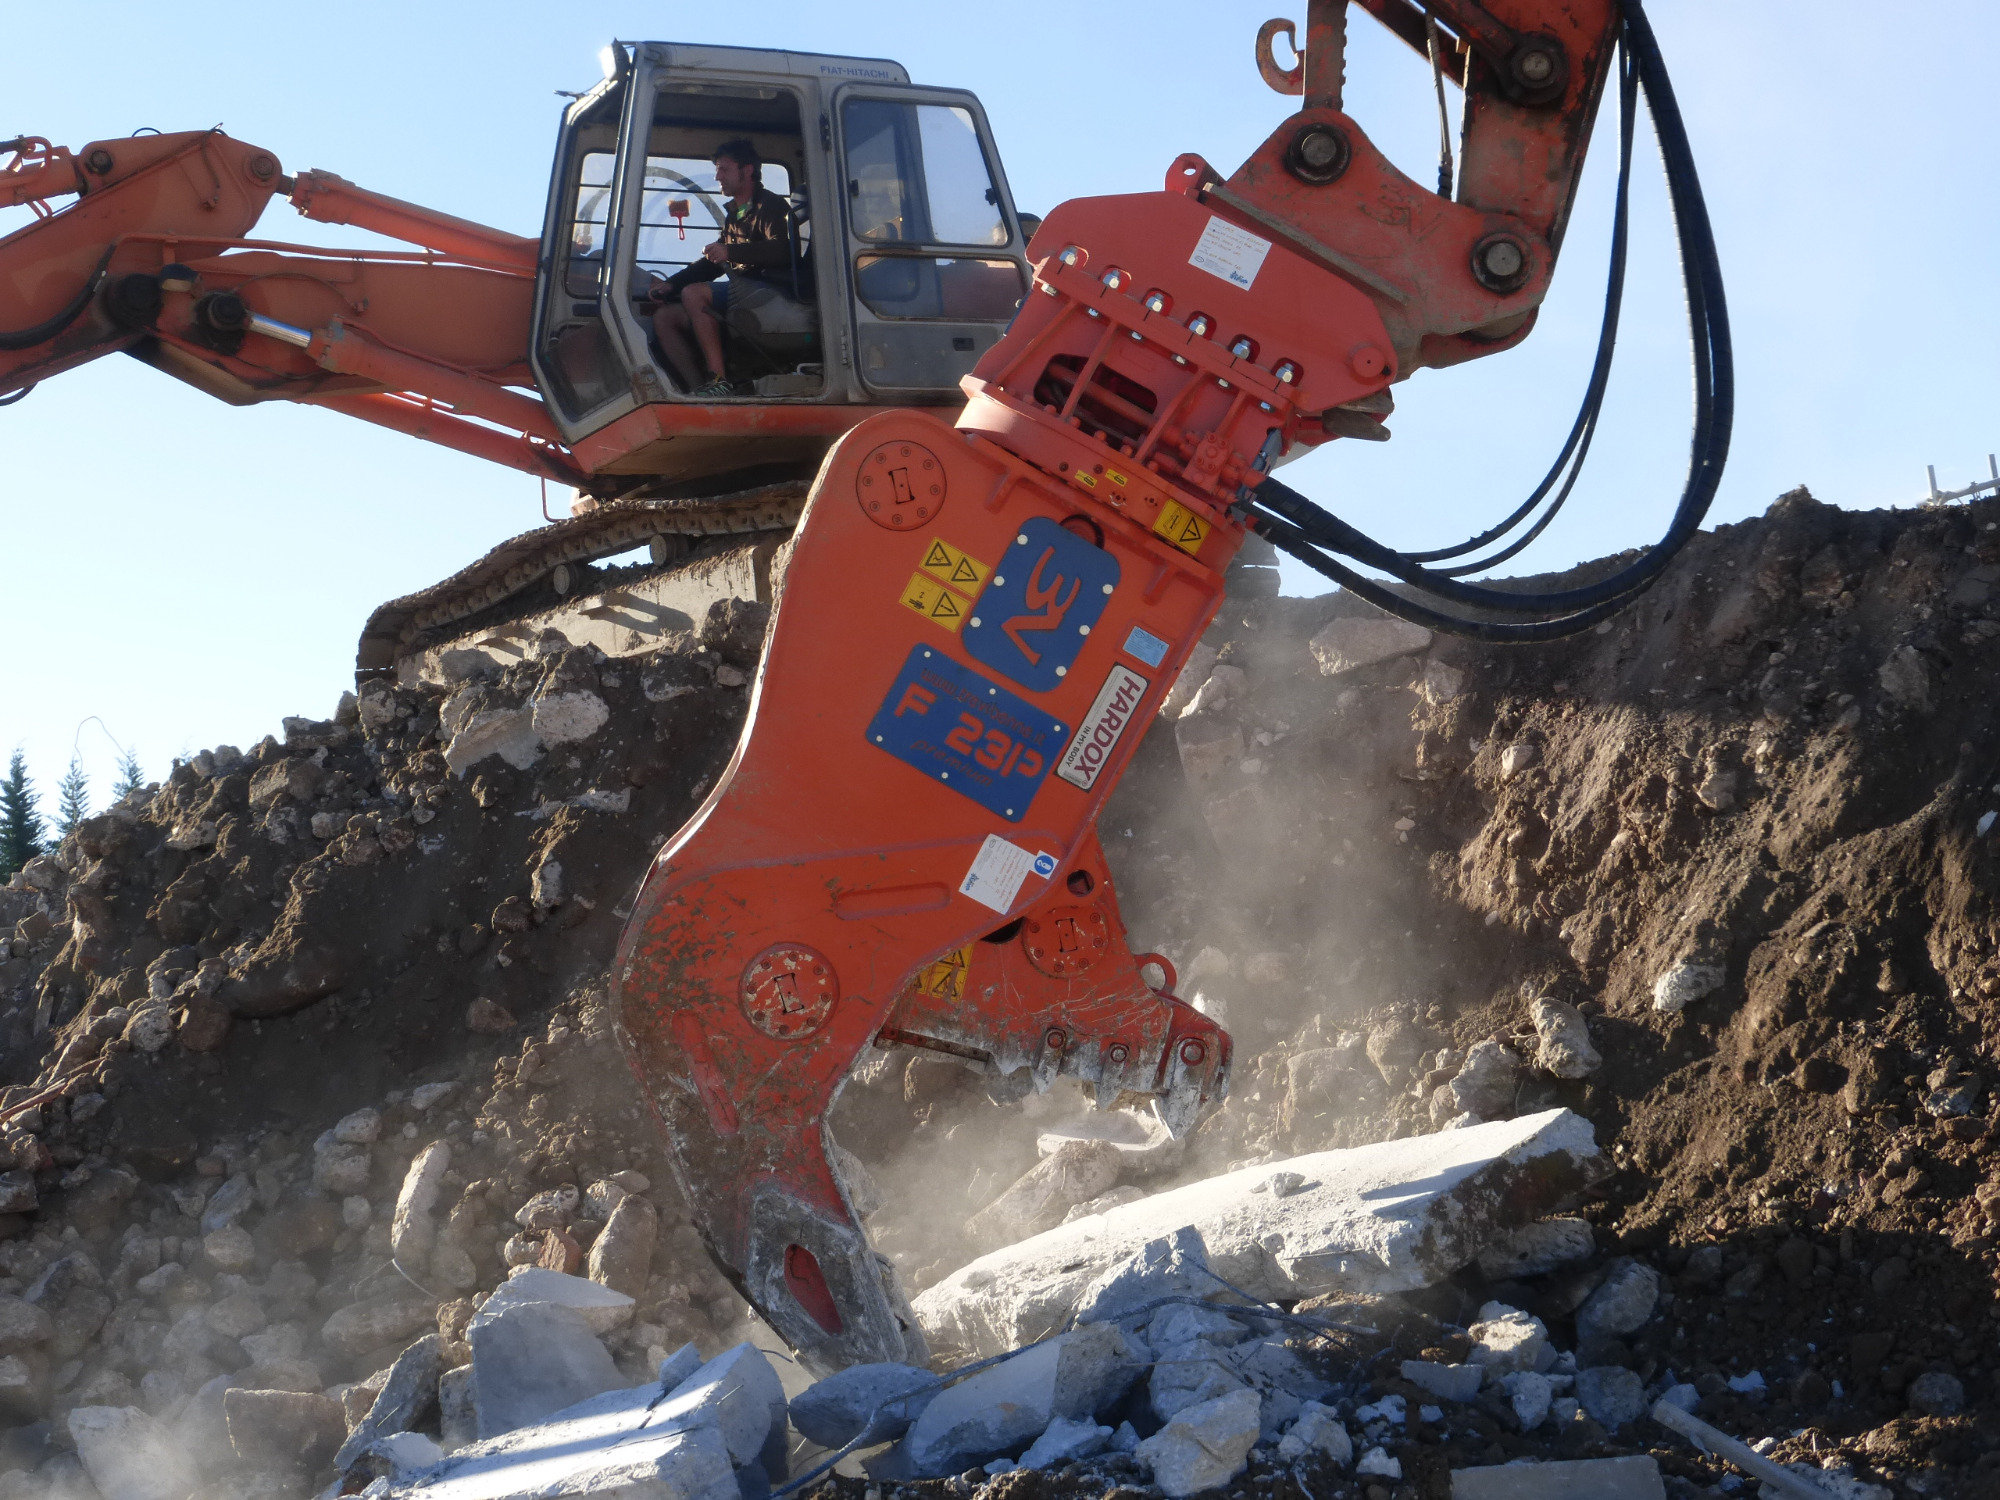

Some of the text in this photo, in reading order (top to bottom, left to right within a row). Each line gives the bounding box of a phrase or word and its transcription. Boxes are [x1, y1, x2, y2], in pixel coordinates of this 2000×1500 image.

[820, 65, 889, 78] FIAT-HITACHI
[894, 682, 937, 718] F
[922, 667, 1046, 747] www.trevibenne.it
[911, 740, 993, 787] premium
[1065, 746, 1081, 768] BODY
